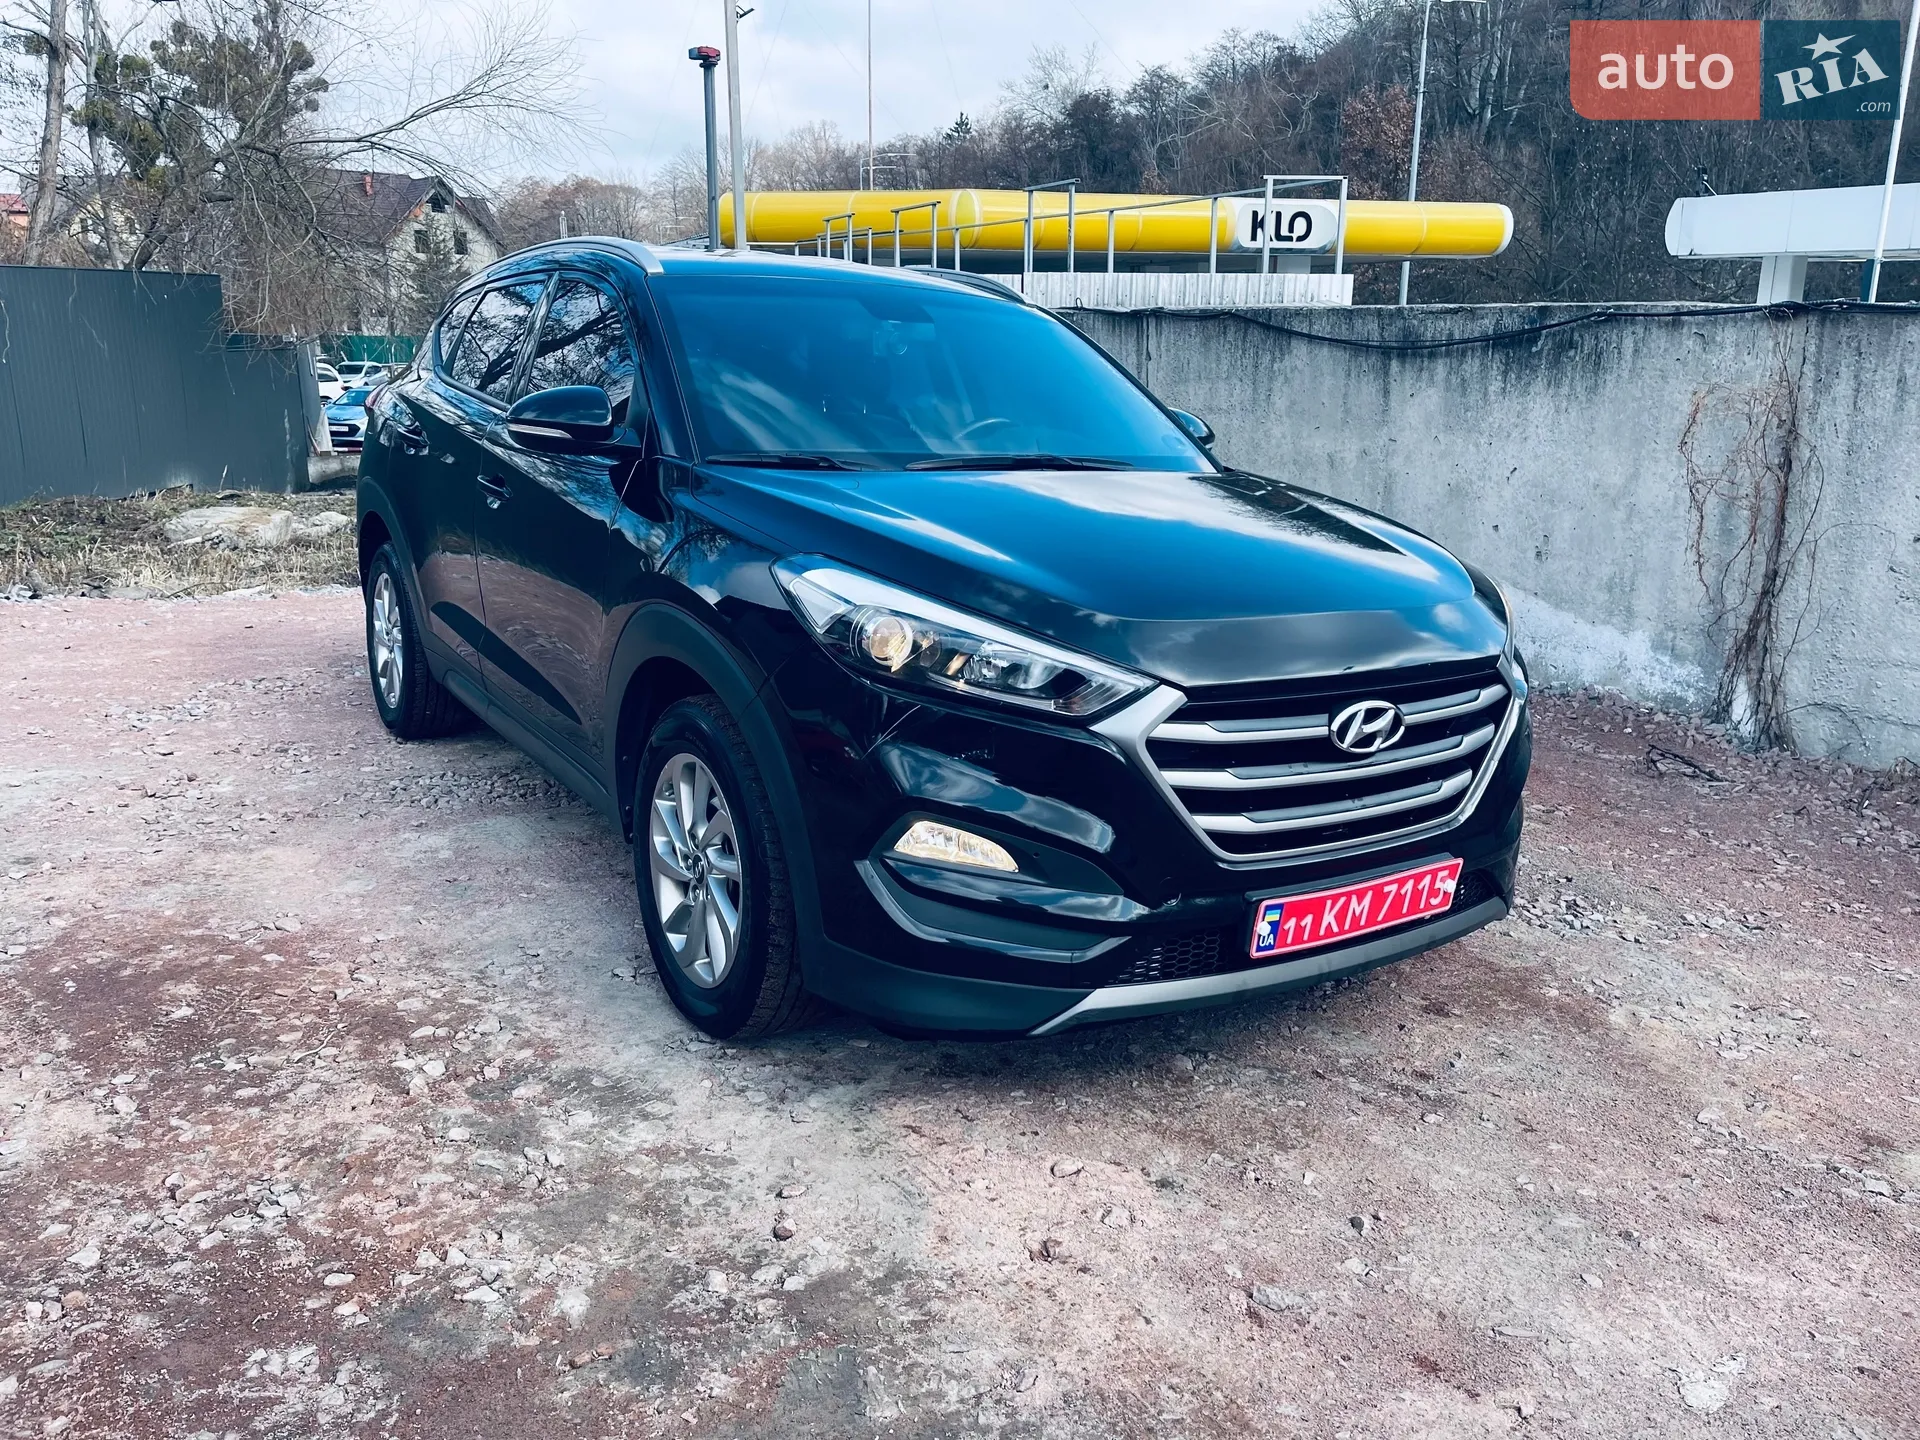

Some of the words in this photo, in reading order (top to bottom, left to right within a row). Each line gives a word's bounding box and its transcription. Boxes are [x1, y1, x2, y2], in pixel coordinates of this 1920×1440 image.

[1250, 210, 1312, 242] KLO
[1283, 914, 1314, 944] 11
[1319, 892, 1372, 936] KM
[1377, 870, 1449, 922] 7115
[1259, 933, 1274, 947] UA
